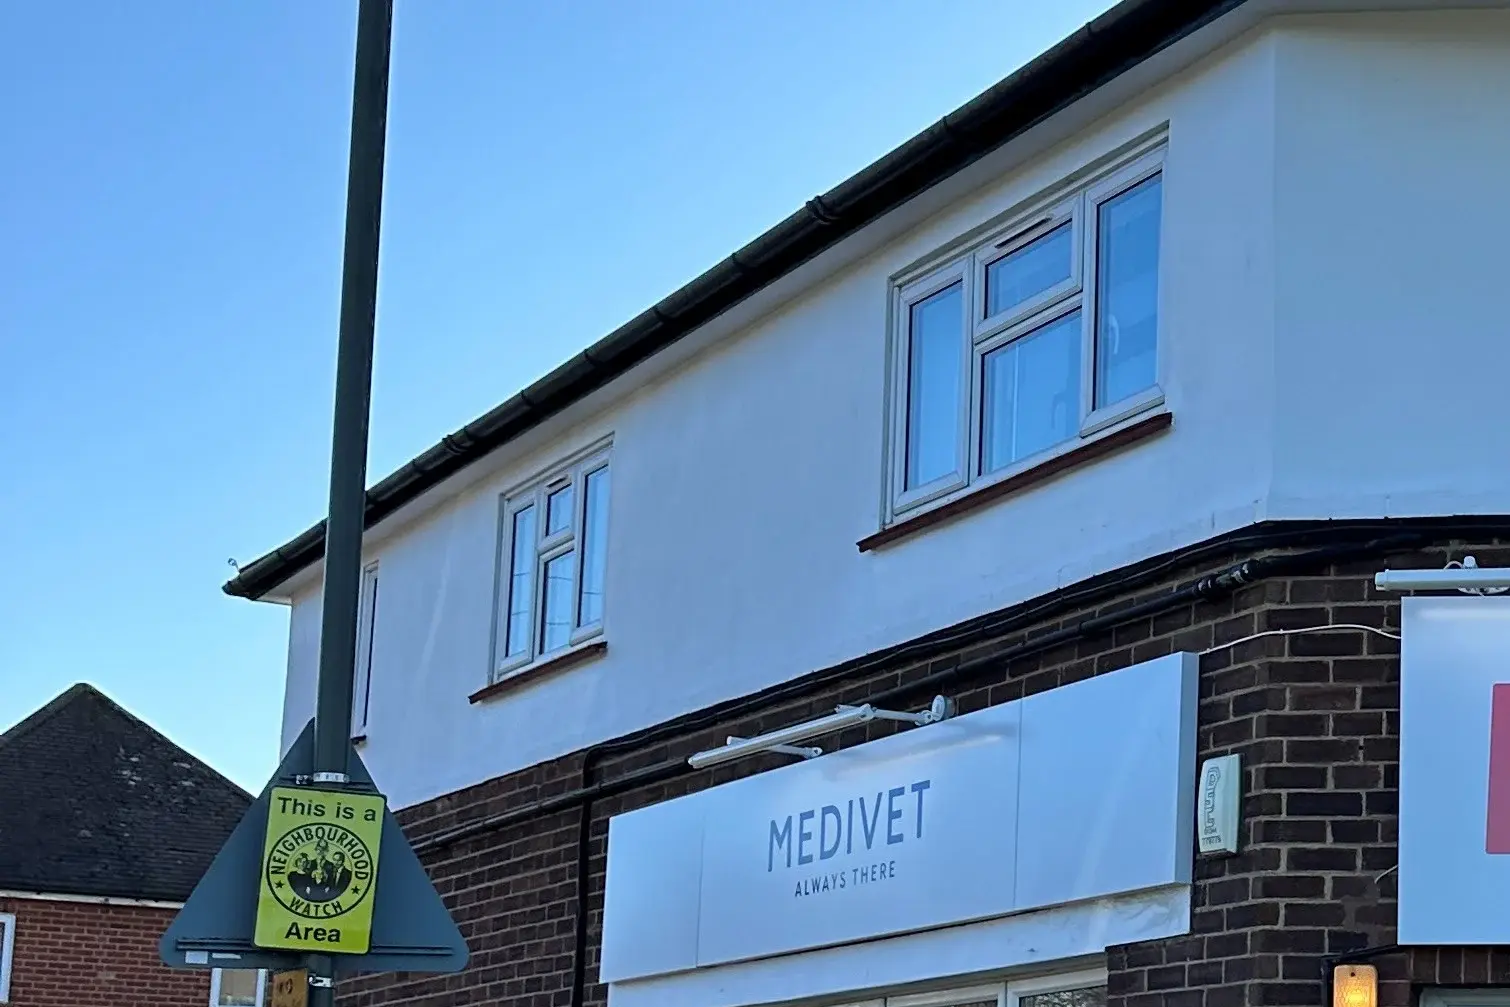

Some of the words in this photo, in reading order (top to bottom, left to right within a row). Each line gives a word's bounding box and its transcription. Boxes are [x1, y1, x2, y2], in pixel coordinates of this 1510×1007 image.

[278, 797, 326, 817] This
[335, 802, 354, 820] is
[364, 807, 376, 822] a
[768, 779, 931, 872] MEDIVET
[271, 826, 369, 881] NEIGHBOURHOOD
[795, 871, 846, 898] ALWAYS
[852, 860, 896, 885] THERE
[289, 896, 343, 917] WATCH
[284, 921, 341, 943] Area
